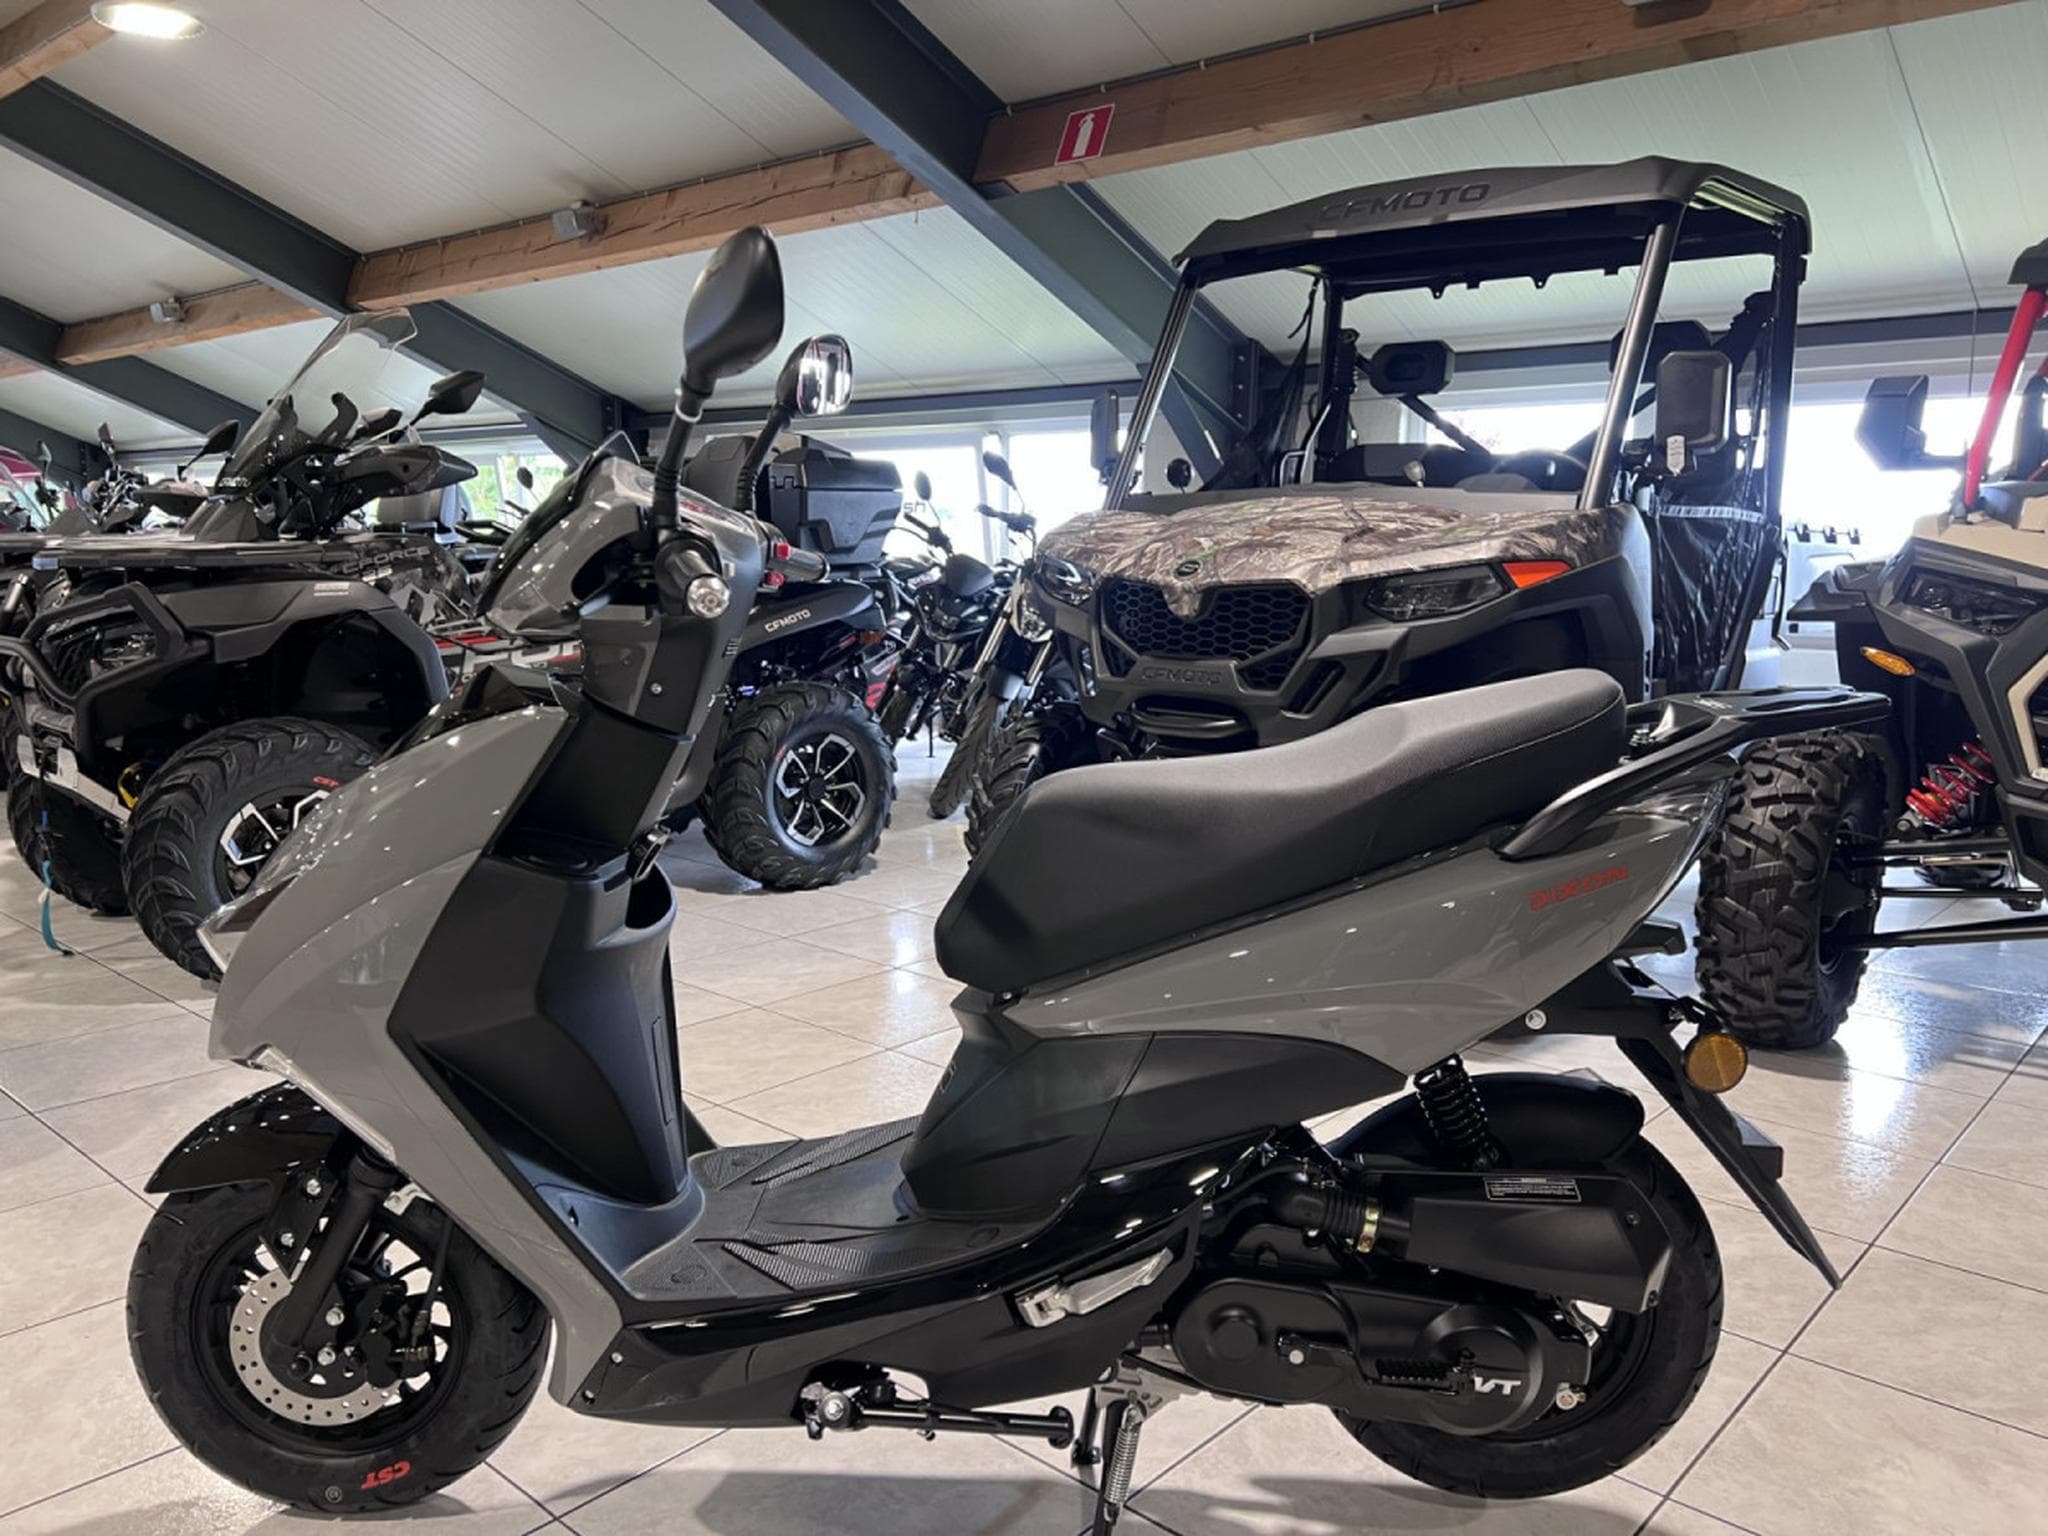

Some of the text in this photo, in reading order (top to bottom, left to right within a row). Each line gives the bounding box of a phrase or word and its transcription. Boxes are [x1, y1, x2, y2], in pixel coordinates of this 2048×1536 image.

[1321, 183, 1491, 222] CFMOTO
[764, 608, 811, 633] CFMOTO
[361, 1460, 411, 1489] CST
